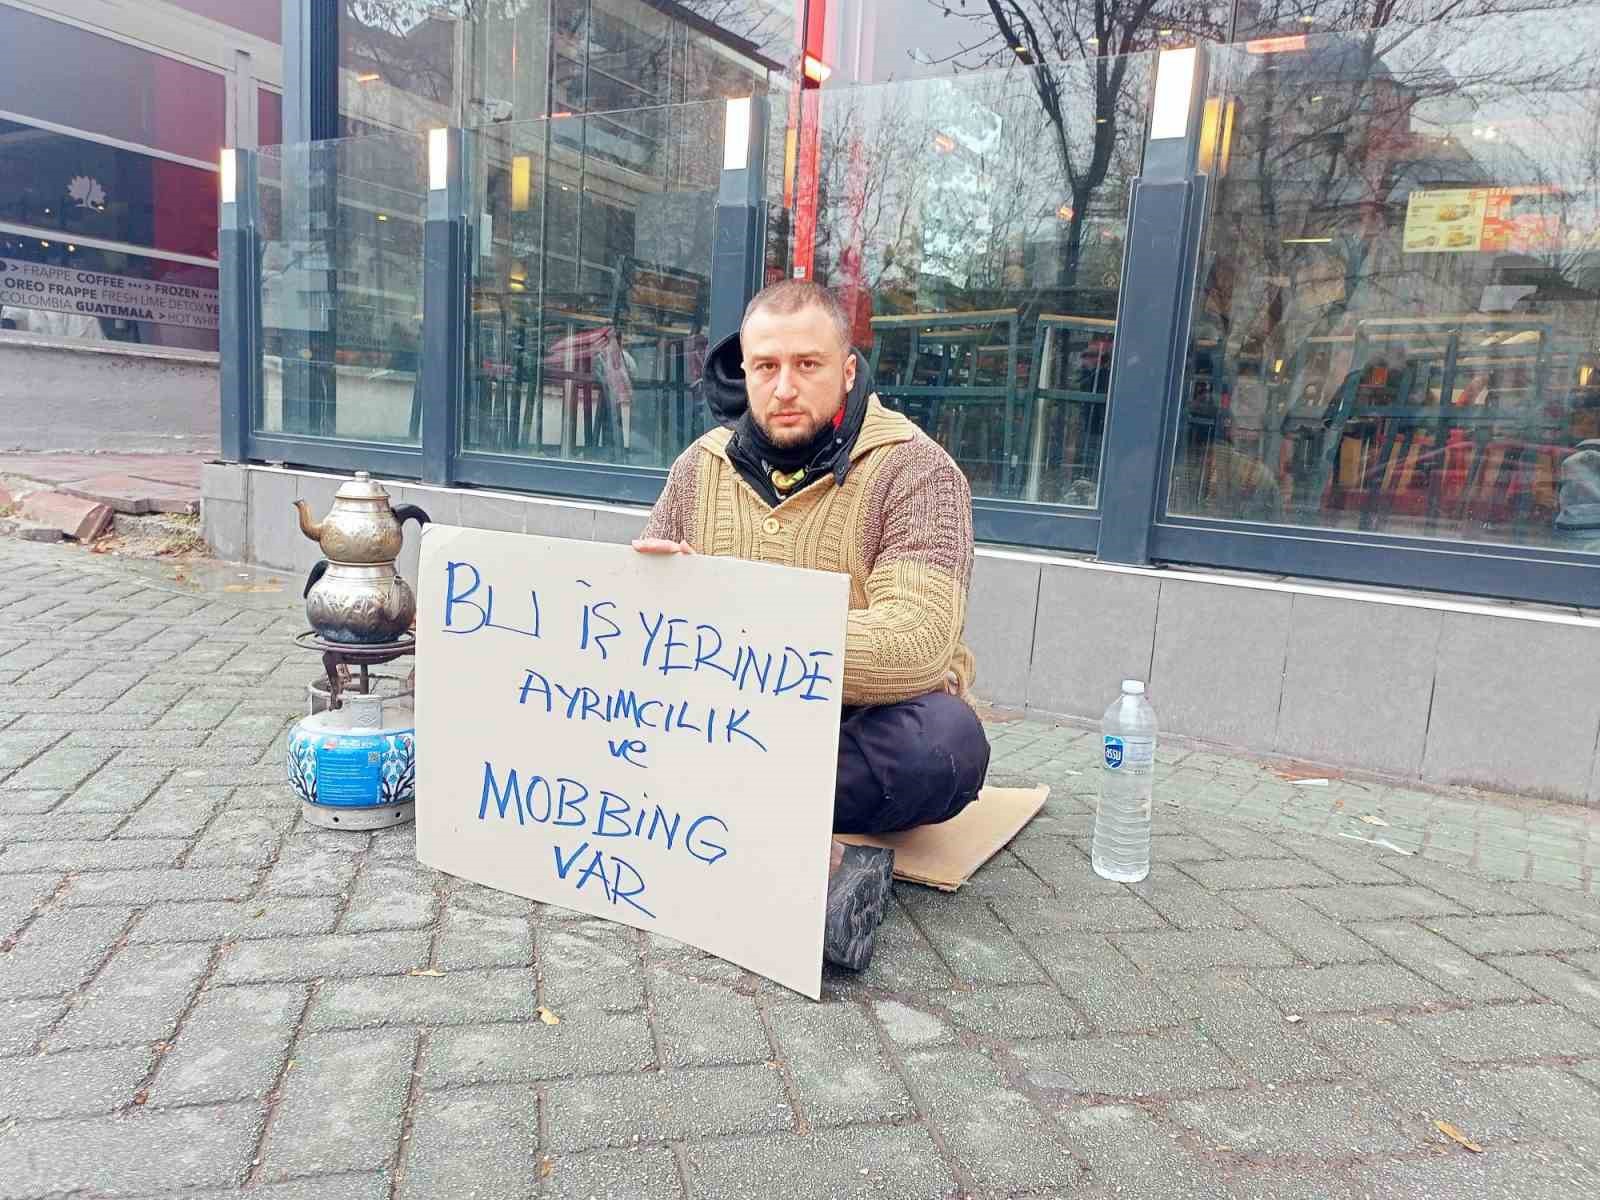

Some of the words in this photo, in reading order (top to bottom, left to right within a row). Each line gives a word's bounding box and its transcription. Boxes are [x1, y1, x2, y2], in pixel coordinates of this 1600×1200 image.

[4, 277, 45, 292] OREO
[48, 283, 97, 299] FRAPPE
[101, 290, 138, 304] FRESH
[140, 294, 168, 308] LIME
[168, 298, 204, 313] DETOX
[23, 266, 71, 282] FRAPPE
[76, 272, 124, 289] COFFEE
[155, 284, 200, 299] FROZEN
[0, 290, 73, 309] COLOMBIA
[75, 301, 153, 319] GUATEMALA
[167, 311, 192, 324] HOT
[519, 669, 767, 752] AYRIMCILIK
[608, 739, 648, 768] ve
[553, 842, 656, 919] VAR
